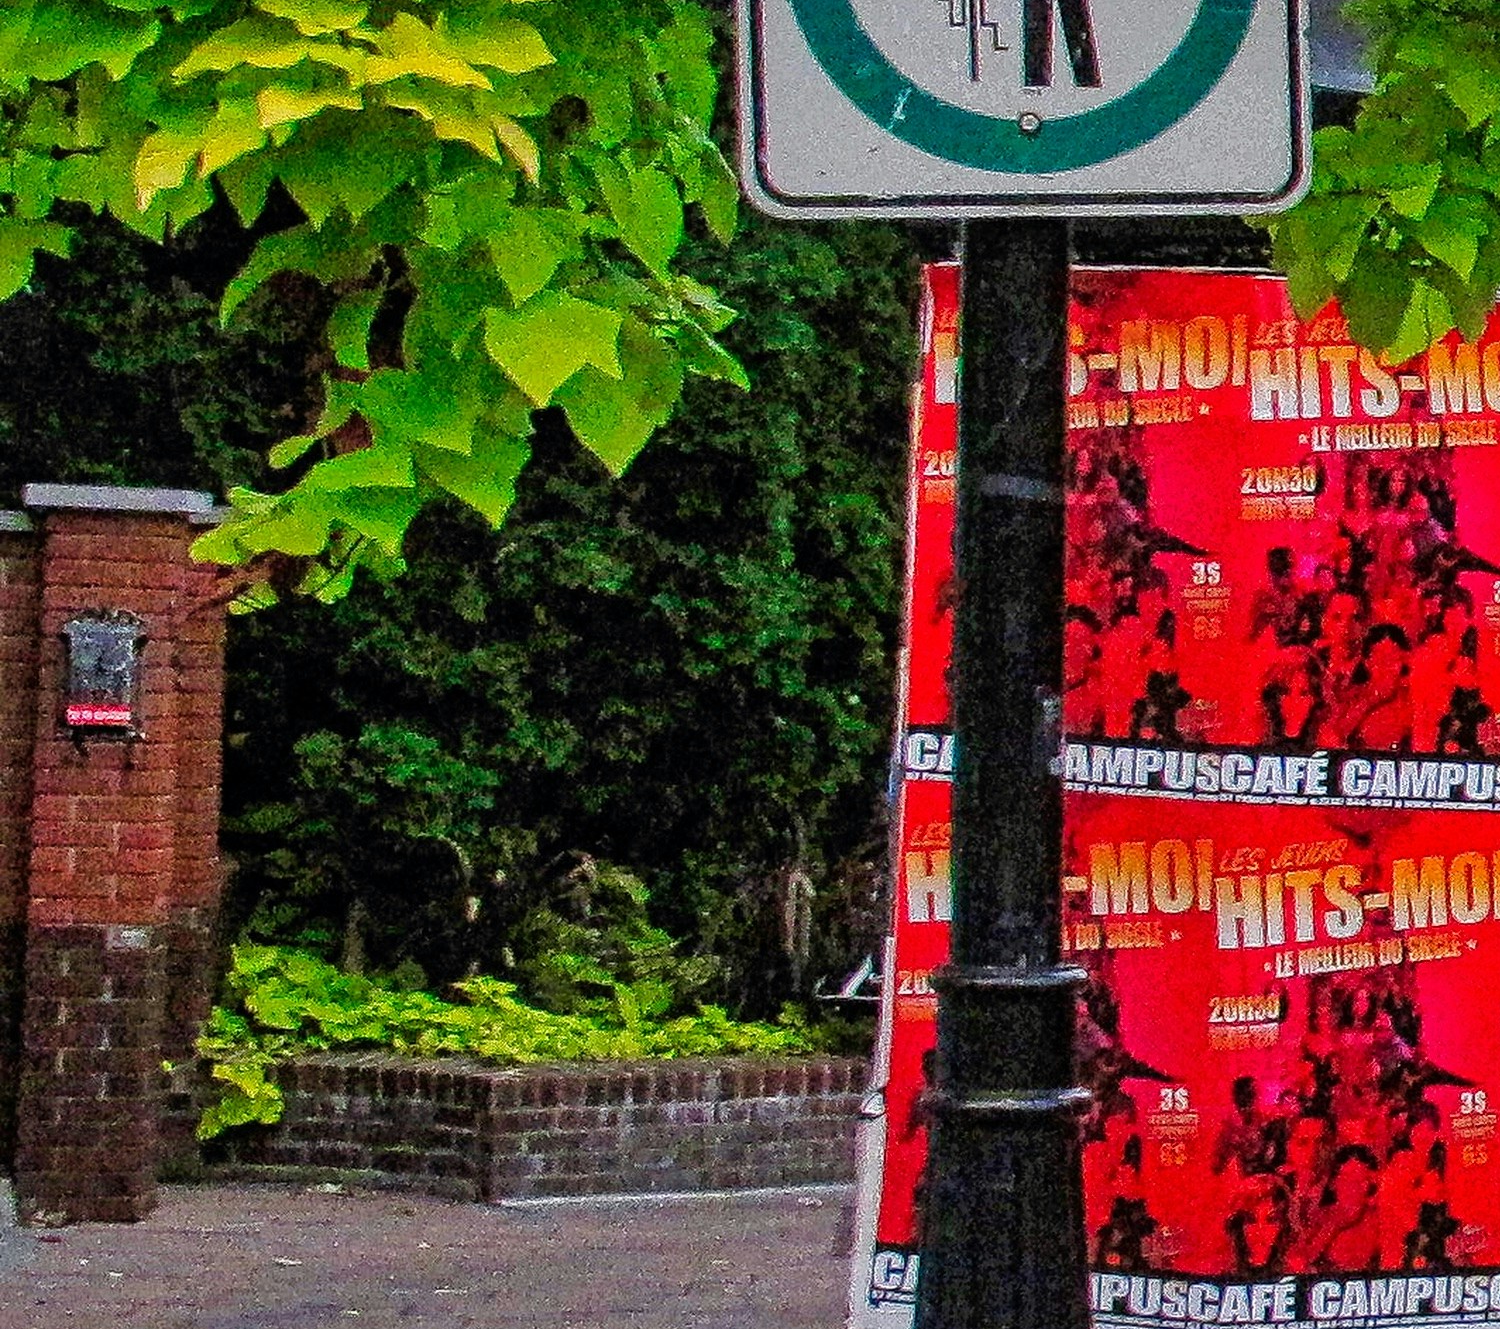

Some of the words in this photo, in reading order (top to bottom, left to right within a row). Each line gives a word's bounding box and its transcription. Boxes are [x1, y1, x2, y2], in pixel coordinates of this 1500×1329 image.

[1313, 425, 1332, 452] LE
[1240, 467, 1317, 494] 20H30
[1065, 743, 1330, 796] AMPUSCAFÉ
[1275, 951, 1295, 979] LE
[1092, 1273, 1296, 1323] PUSCAFÉ
